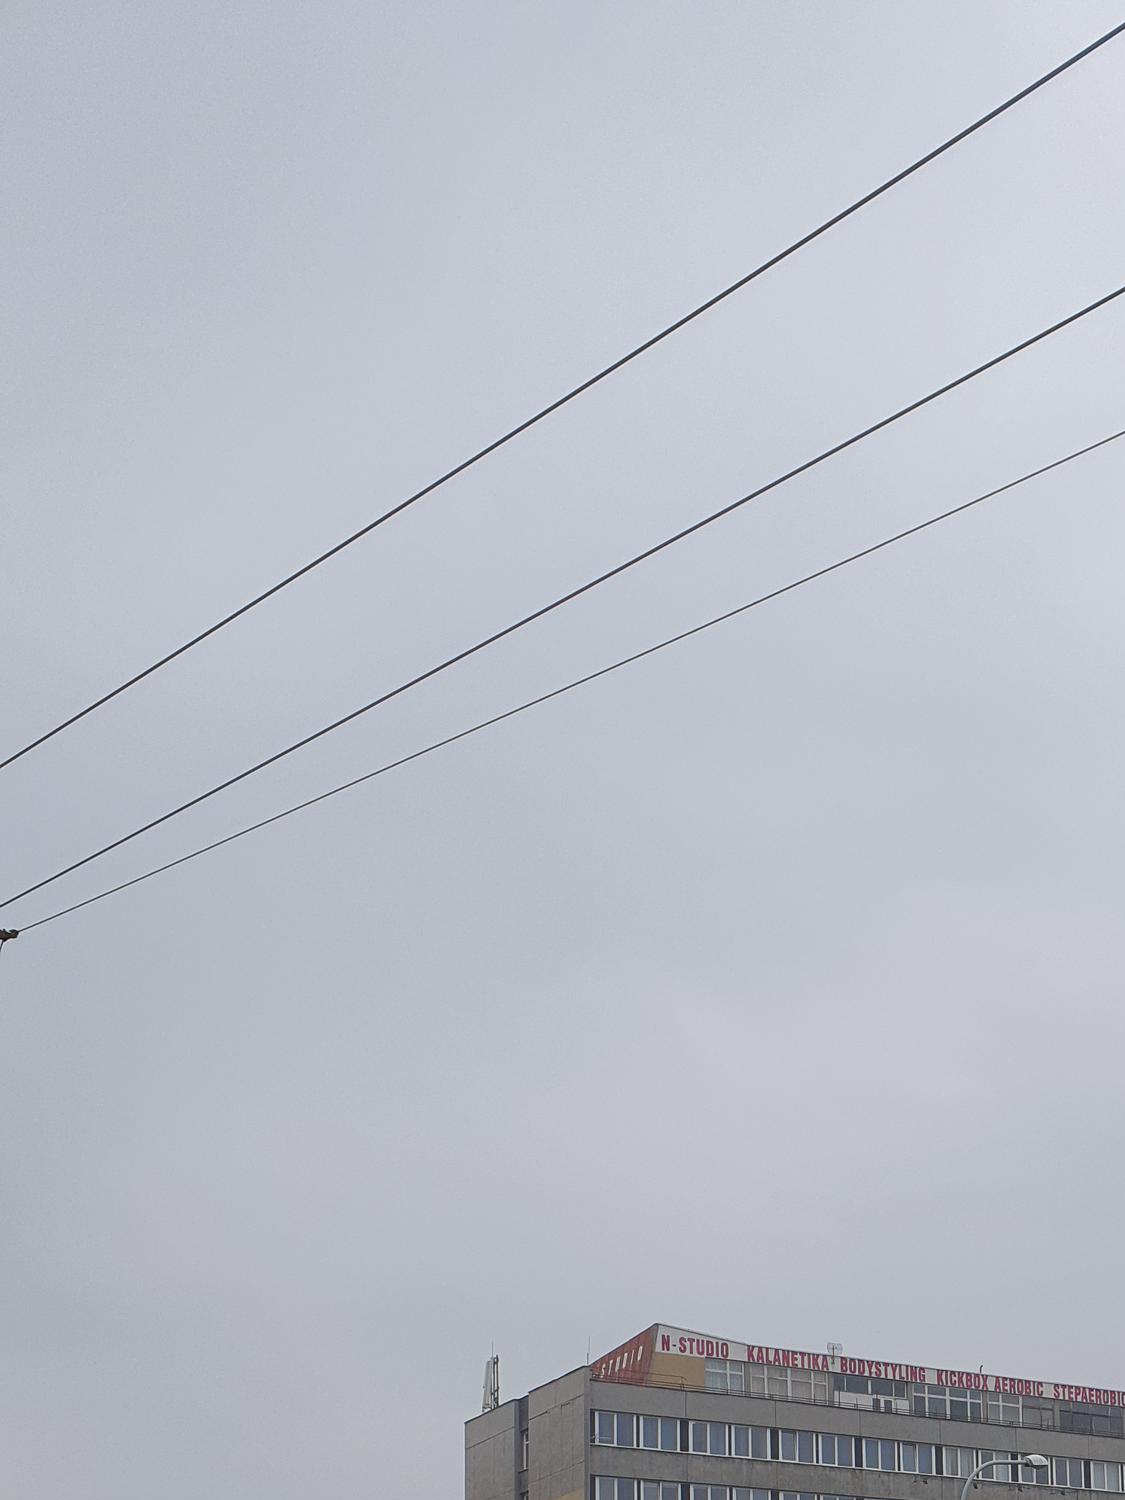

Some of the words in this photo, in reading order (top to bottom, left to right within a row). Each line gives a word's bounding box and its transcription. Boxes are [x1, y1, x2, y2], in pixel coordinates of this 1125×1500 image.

[600, 1345, 644, 1378] STUDIO
[661, 1334, 729, 1359] N-STUDIO
[746, 1344, 829, 1371] KALANETIKA
[840, 1357, 926, 1382] BODYSTYLING
[936, 1368, 988, 1391] KICKBOX
[994, 1376, 1044, 1397] AEROBIC
